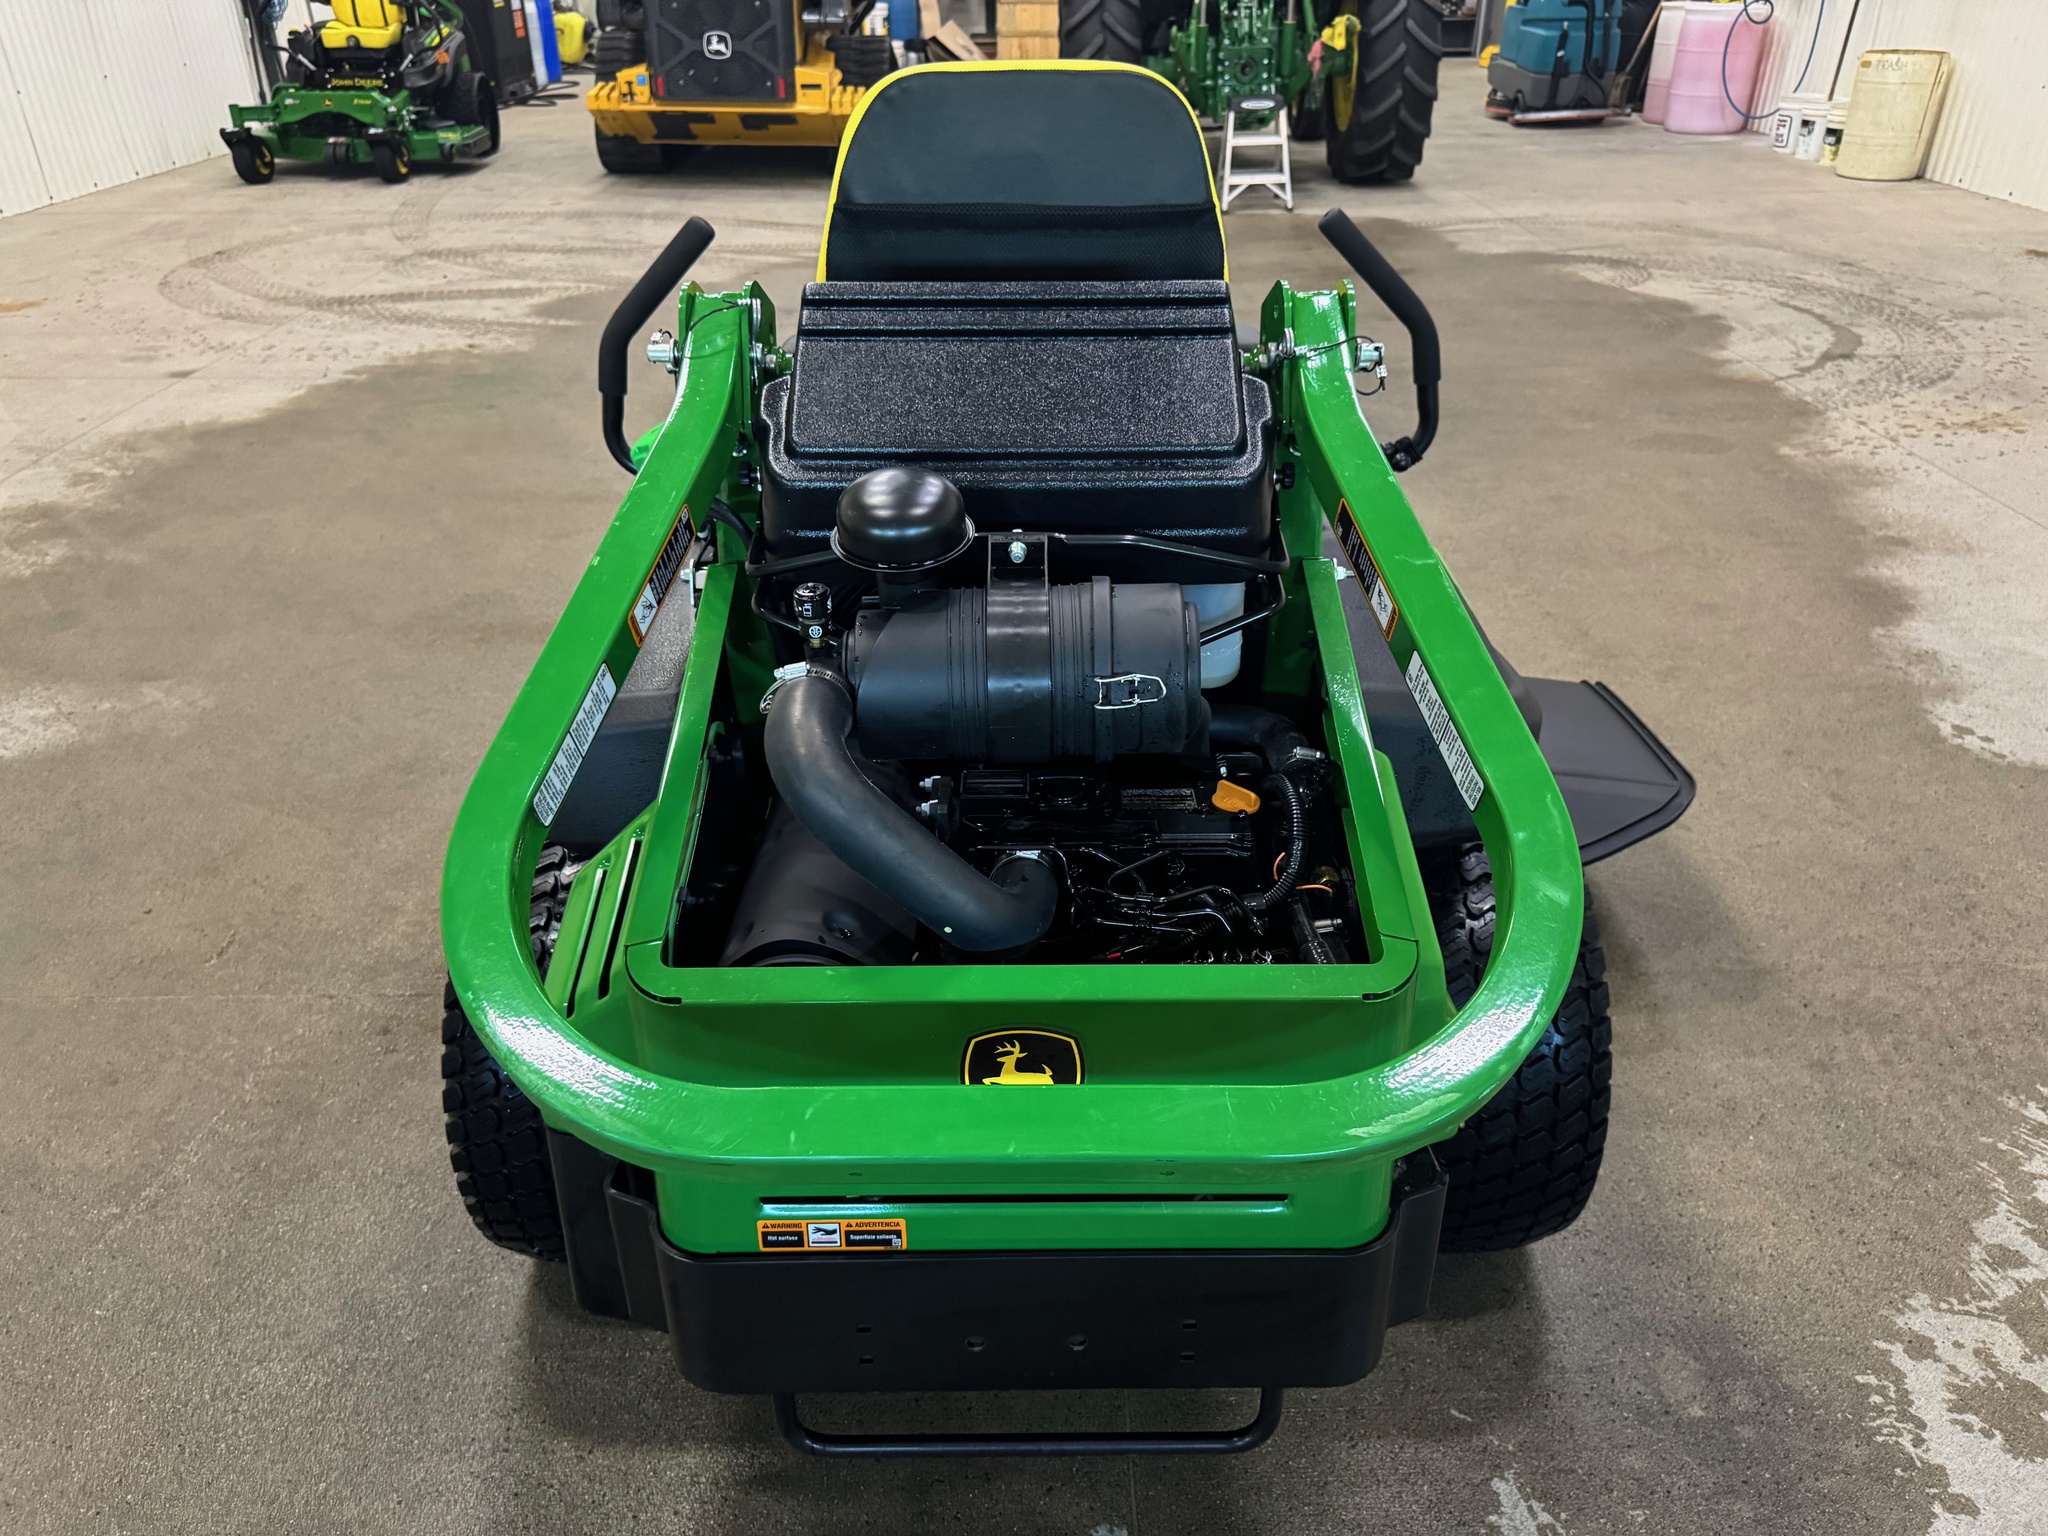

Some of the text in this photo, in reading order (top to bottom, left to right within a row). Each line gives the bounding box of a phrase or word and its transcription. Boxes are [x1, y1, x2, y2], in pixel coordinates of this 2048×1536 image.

[1876, 57, 1908, 71] TRASH
[331, 78, 384, 87] JOHN DEERE
